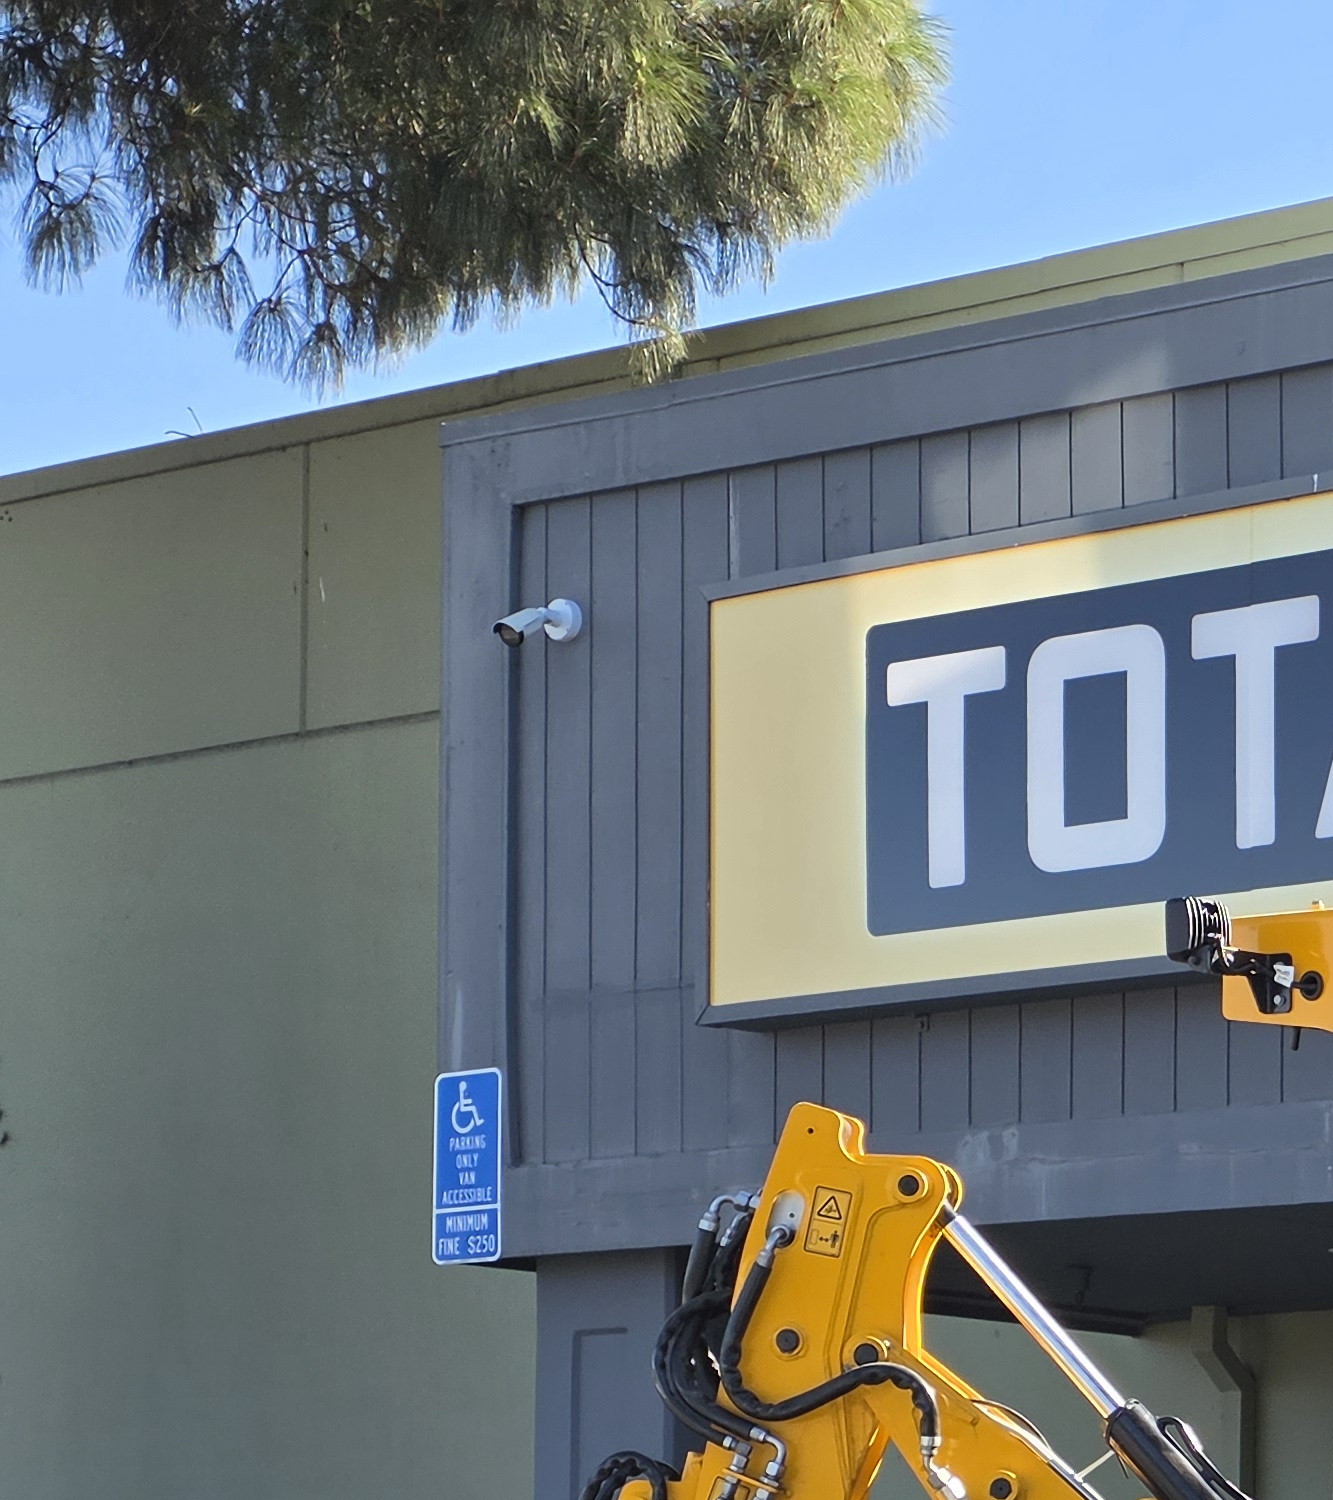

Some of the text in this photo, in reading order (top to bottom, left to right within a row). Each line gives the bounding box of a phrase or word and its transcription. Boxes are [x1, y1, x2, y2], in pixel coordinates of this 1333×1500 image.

[450, 1134, 486, 1151] PARKING
[456, 1153, 478, 1169] ONLY
[459, 1171, 475, 1185] VAN
[441, 1186, 492, 1205] ACCESSIBLE
[446, 1213, 489, 1233] MINIMUM
[438, 1234, 495, 1256] FINE $250
